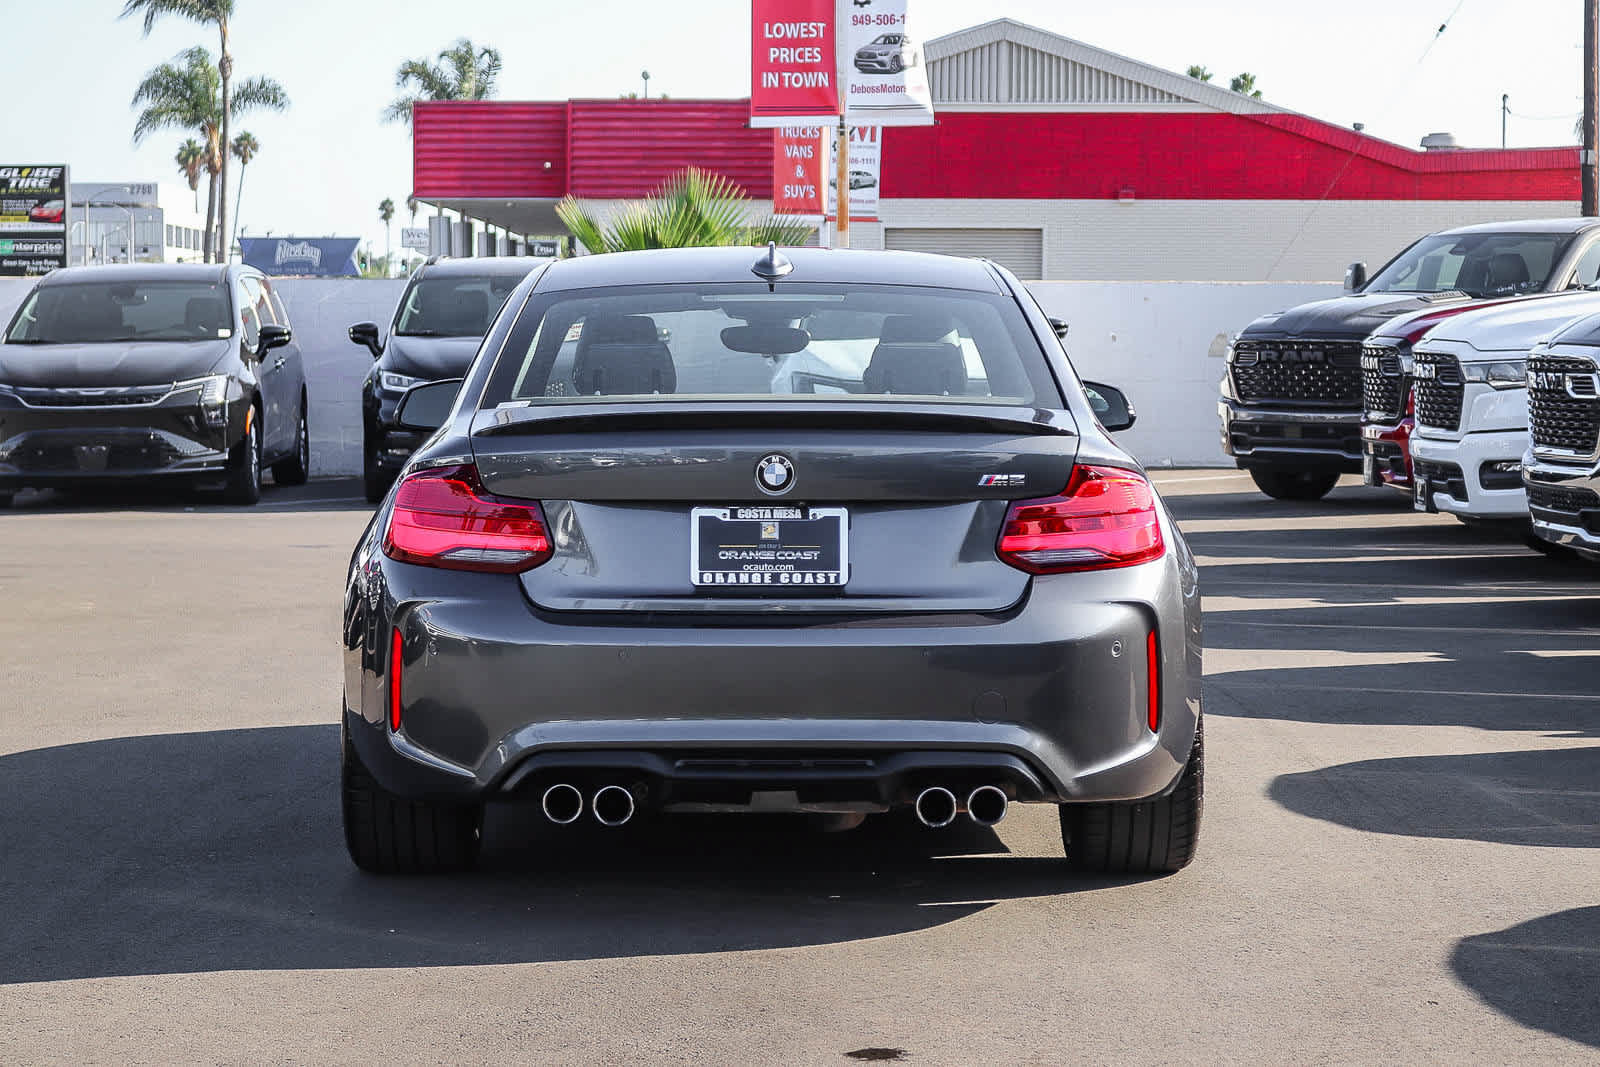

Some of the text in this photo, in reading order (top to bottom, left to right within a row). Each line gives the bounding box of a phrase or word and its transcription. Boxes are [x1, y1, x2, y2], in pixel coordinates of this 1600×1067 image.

[764, 22, 826, 39] LOWEST
[769, 47, 822, 63] PRICES
[762, 72, 829, 88] IN TOWN
[780, 125, 820, 139] TRUCKS
[785, 144, 814, 158] VANS
[0, 167, 62, 178] GLOBE
[795, 164, 805, 179] &
[8, 178, 52, 189] TIRE
[783, 184, 816, 199] SUV'S
[1260, 350, 1324, 362] RAM
[737, 508, 802, 519] COSTA MESA
[718, 551, 820, 560] ORANGE COAST
[743, 563, 794, 571] ocauto.com
[702, 572, 837, 584] ORANGE COAST
